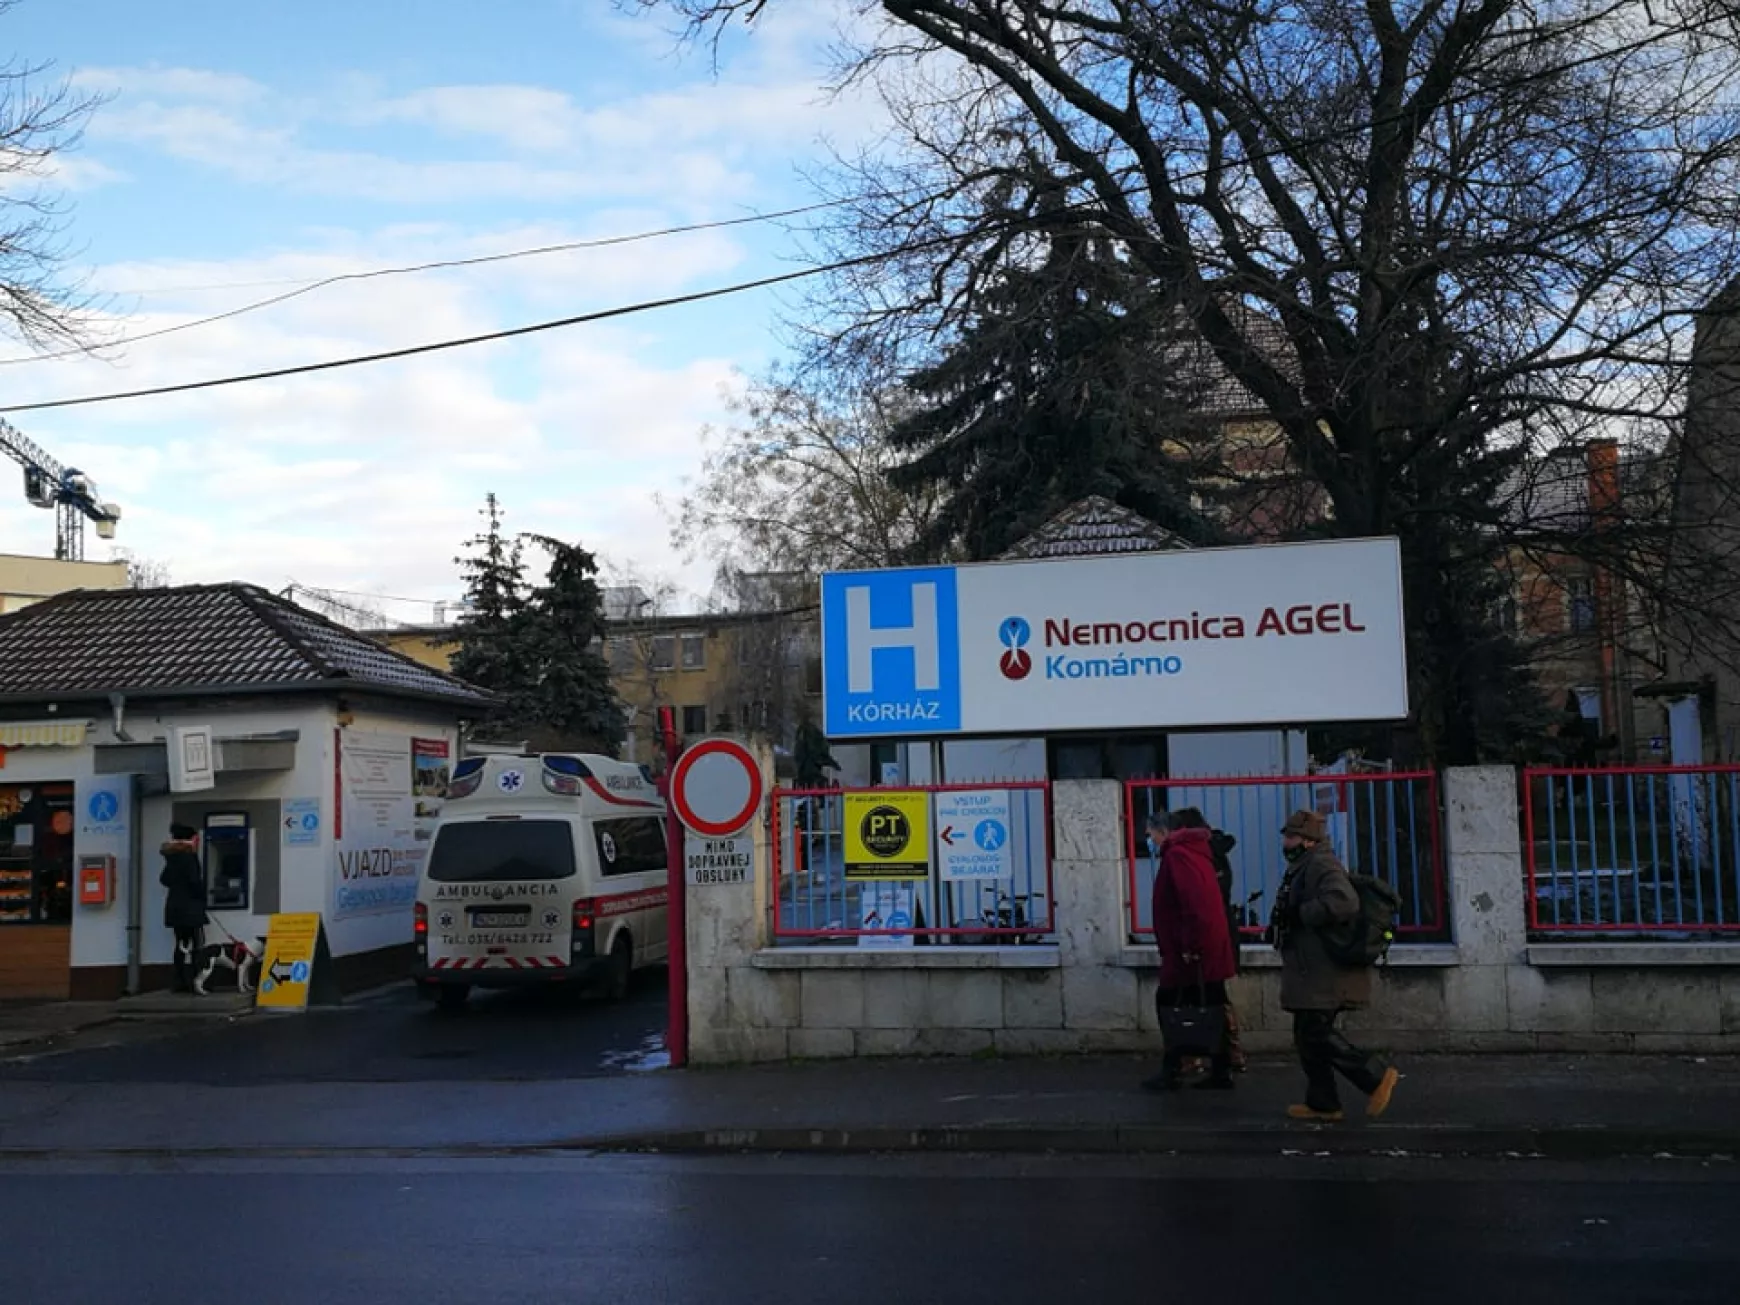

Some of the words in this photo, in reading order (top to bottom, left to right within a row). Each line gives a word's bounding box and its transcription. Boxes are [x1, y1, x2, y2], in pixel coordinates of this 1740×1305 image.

[1045, 611, 1245, 647] Nemocnica
[1256, 603, 1366, 637] AGEL
[846, 582, 939, 693] H
[1046, 652, 1182, 679] Komárno
[849, 699, 941, 722] KÓRHÁZ
[953, 796, 991, 805] VSTUP
[871, 815, 900, 835] PT
[704, 839, 735, 854] MIMO
[338, 847, 392, 880] VJAZD
[688, 853, 750, 868] DOPRAVNEJ
[695, 868, 746, 884] OBSLUHY
[436, 884, 559, 897] AMBULANCIA
